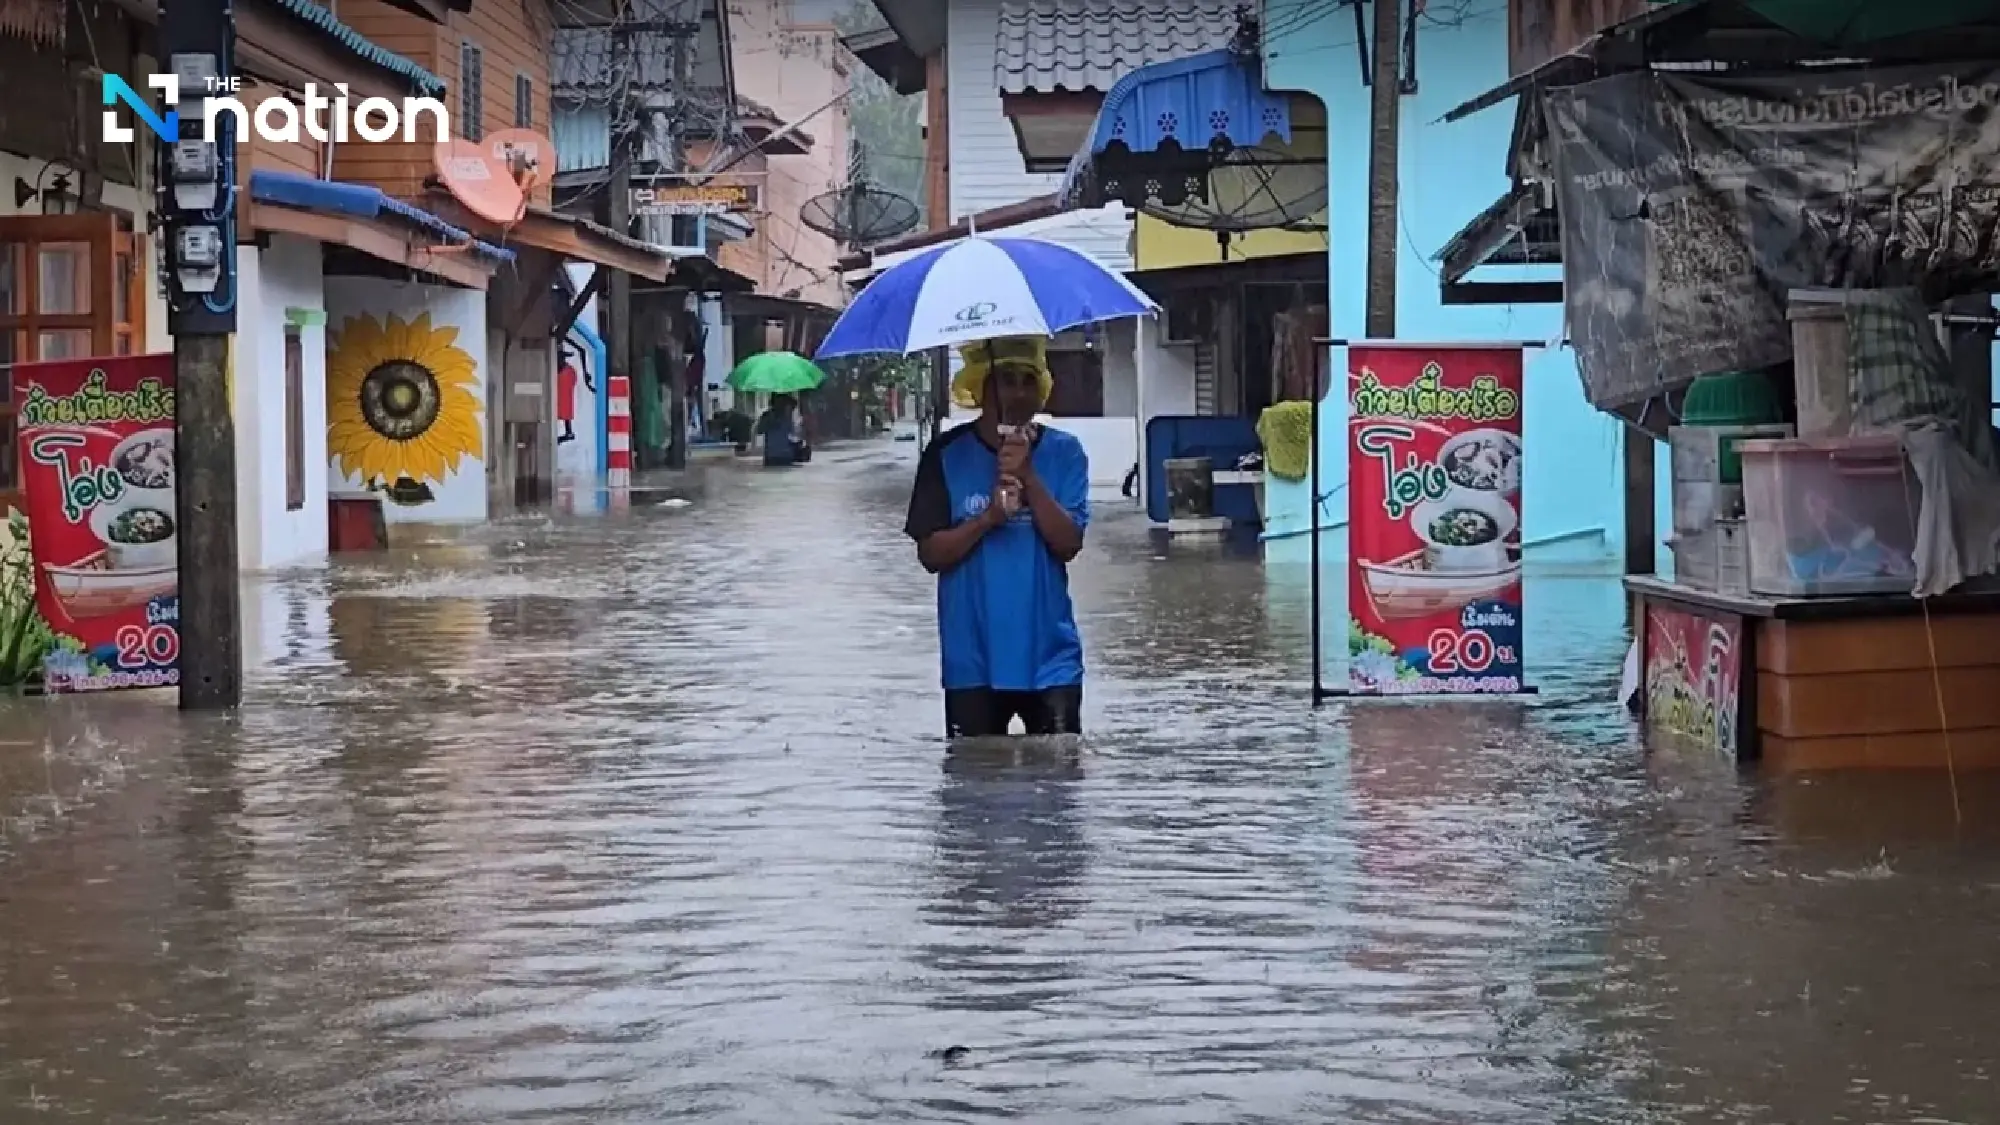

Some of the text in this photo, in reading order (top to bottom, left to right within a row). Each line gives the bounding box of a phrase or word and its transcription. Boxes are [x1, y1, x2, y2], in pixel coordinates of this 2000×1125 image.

[1354, 362, 1519, 422] ก๋วยเตี๋ยวเรือ
[31, 433, 127, 524] โอ่ง
[1357, 424, 1450, 520] โอ่ง
[1461, 600, 1516, 627] เริ่มต้น
[116, 624, 179, 667] 20
[1427, 628, 1495, 673] 20
